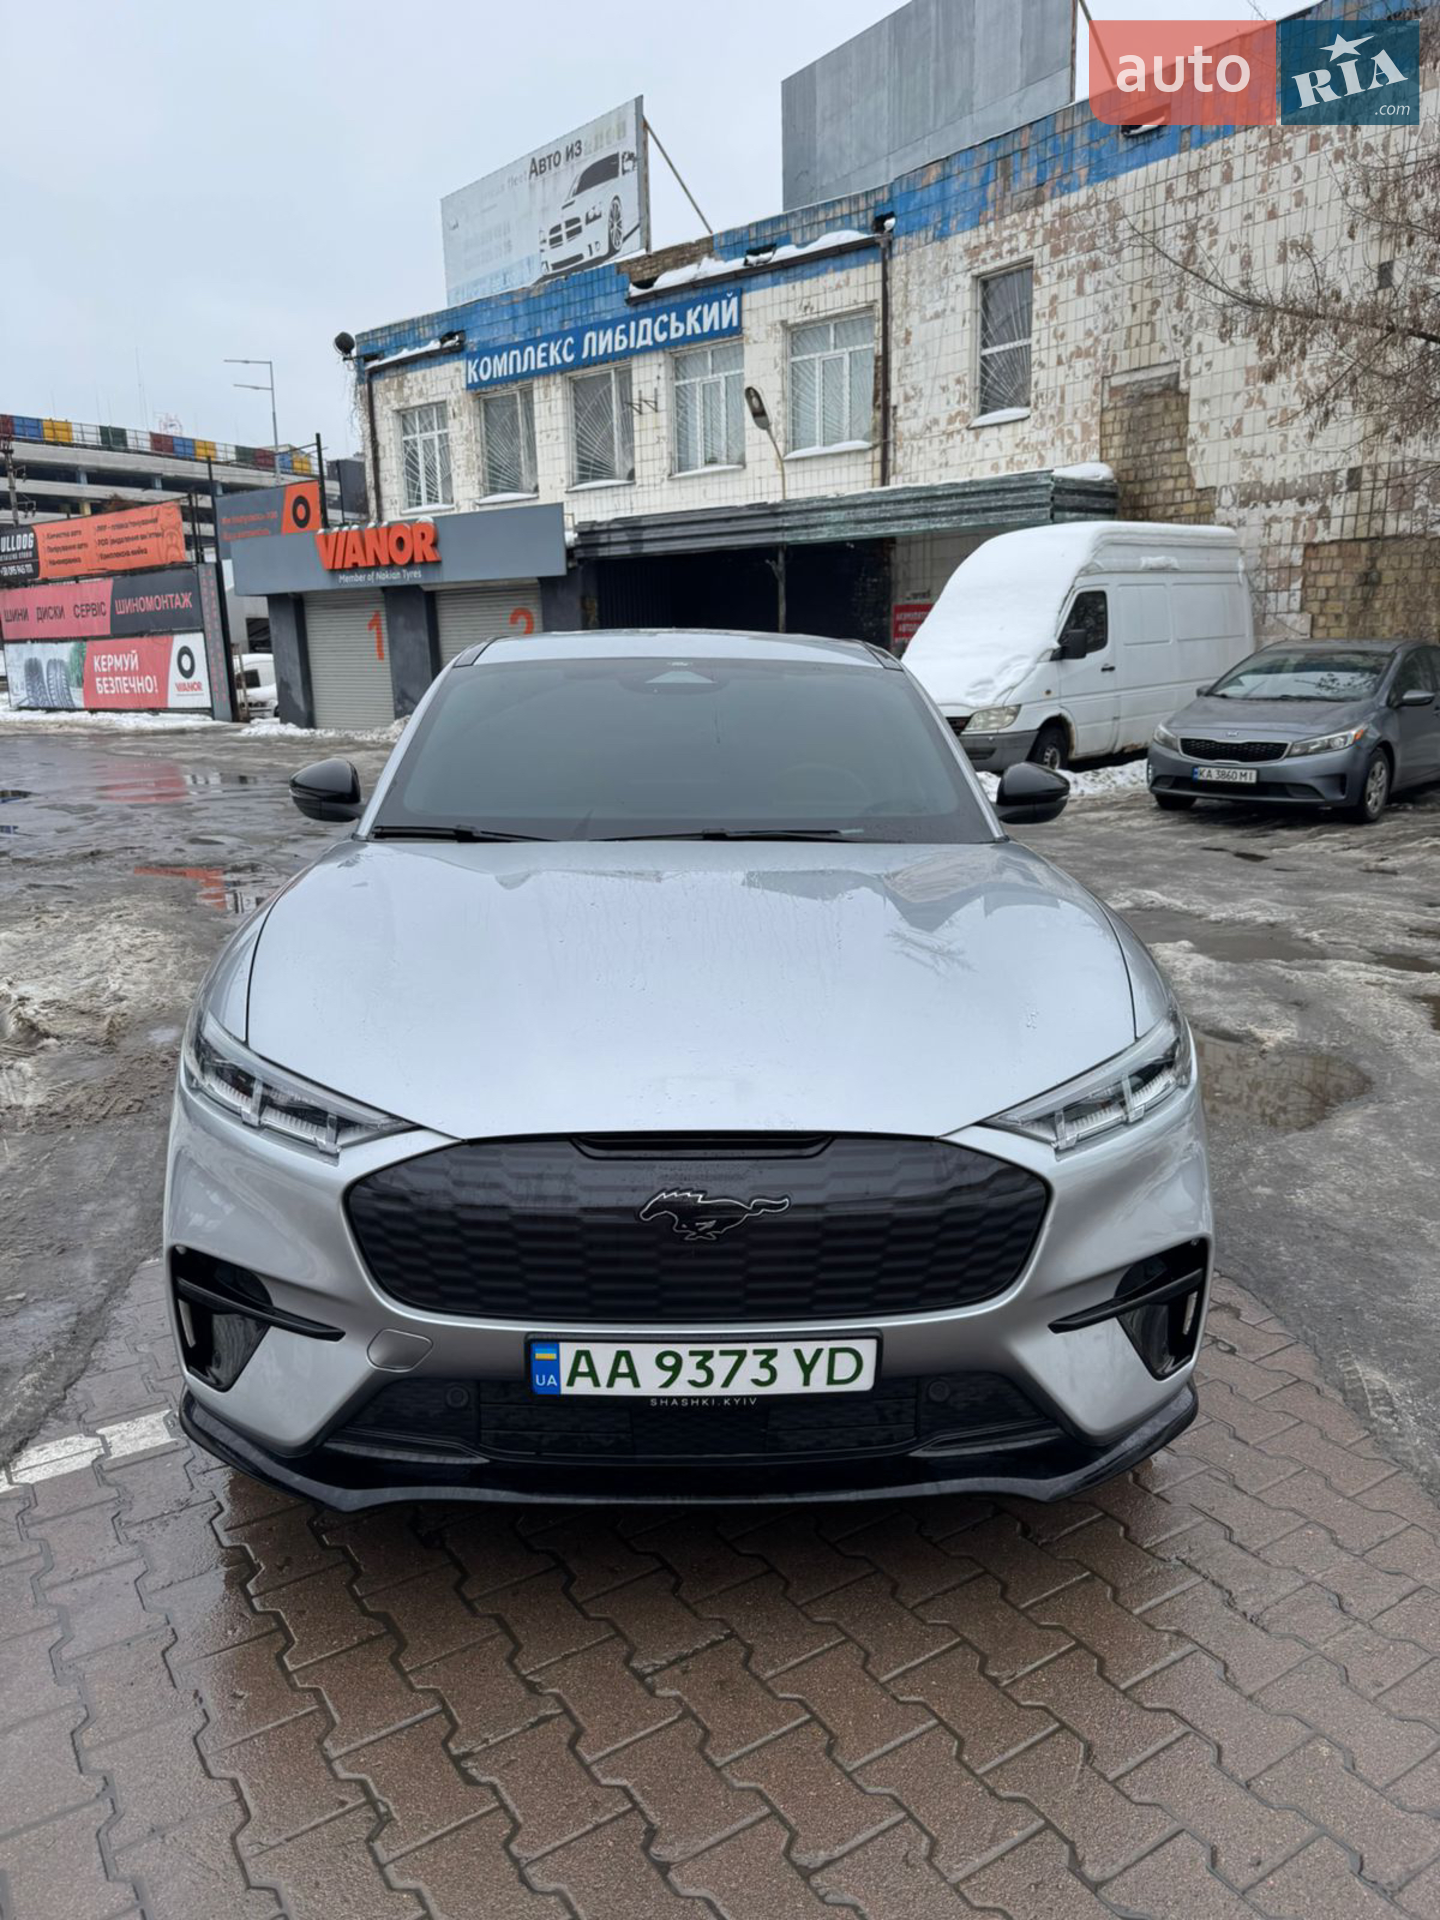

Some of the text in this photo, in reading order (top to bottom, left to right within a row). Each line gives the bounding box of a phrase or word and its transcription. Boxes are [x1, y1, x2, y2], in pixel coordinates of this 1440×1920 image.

[466, 292, 739, 385] КОМПЛЕКС ЛИБІДСЬКИЙ
[1, 532, 34, 553] ULLDOG
[314, 522, 442, 570] VIANOR
[338, 569, 422, 583] Member of Nokian Tyres
[4, 601, 107, 623] ШИНИ ДИСКИ СЕРВІС
[114, 592, 193, 615] ШИНОМОНТАЖ
[367, 610, 384, 661] 1
[93, 650, 139, 673] КЕРМУЙ
[95, 675, 159, 695] БЕЗПЕЧНО!
[566, 1346, 864, 1389] AA 9373 YD
[535, 1374, 558, 1387] UA
